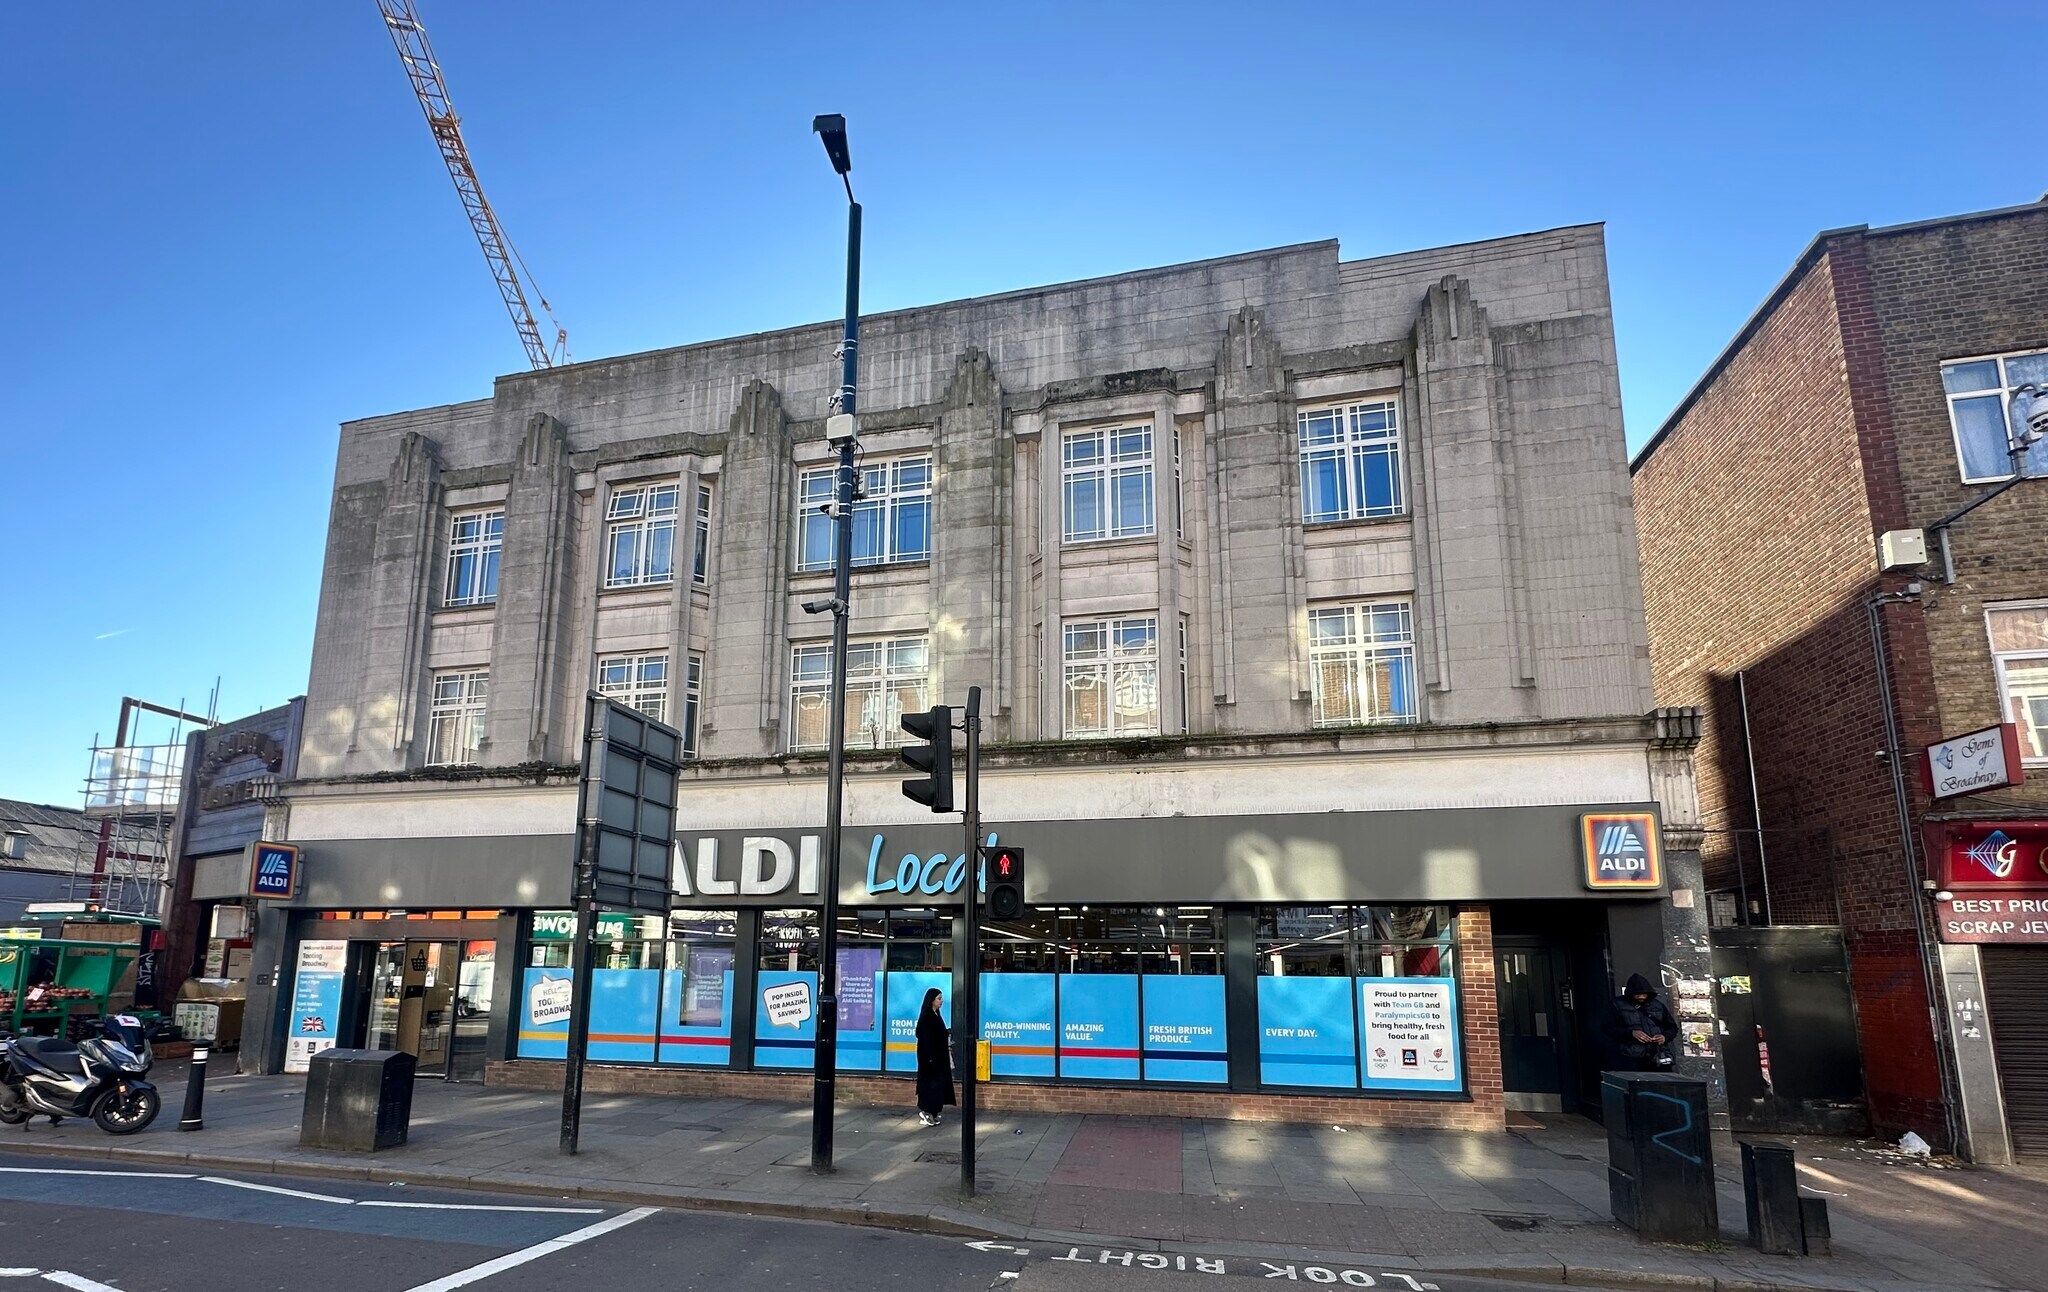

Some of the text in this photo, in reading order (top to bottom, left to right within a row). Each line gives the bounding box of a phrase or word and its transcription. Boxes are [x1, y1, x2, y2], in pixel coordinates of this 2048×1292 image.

[1961, 738, 1995, 758] Gems
[1979, 751, 1990, 770] of
[1940, 771, 1997, 791] Broadway
[1600, 858, 1646, 871] ALDI
[258, 875, 288, 888] ALDI
[1952, 900, 2003, 912] BEST
[1948, 921, 2014, 934] SCRAP
[771, 989, 803, 1001] POP INSIDE
[537, 994, 569, 1007] TOOTG
[782, 998, 807, 1008] AMAZING
[777, 1008, 802, 1017] SAVINGS
[1375, 1012, 1431, 1020] ParalympicsGB
[984, 1022, 1051, 1031] AWARD-WINNING
[1065, 1023, 1104, 1032] AMAZING
[1149, 1025, 1212, 1034] FRESH BRITISH
[1372, 1022, 1392, 1030] bring
[1394, 1022, 1424, 1031] healthy,
[891, 1028, 901, 1036] TO
[984, 1030, 1020, 1039] QUALITY.
[1065, 1032, 1093, 1041] VALUE.
[1265, 1028, 1318, 1038] EVERY DAY.
[1149, 1034, 1191, 1043] PRODUCE.
[1051, 1247, 1424, 1292] LOOK RIGHT
